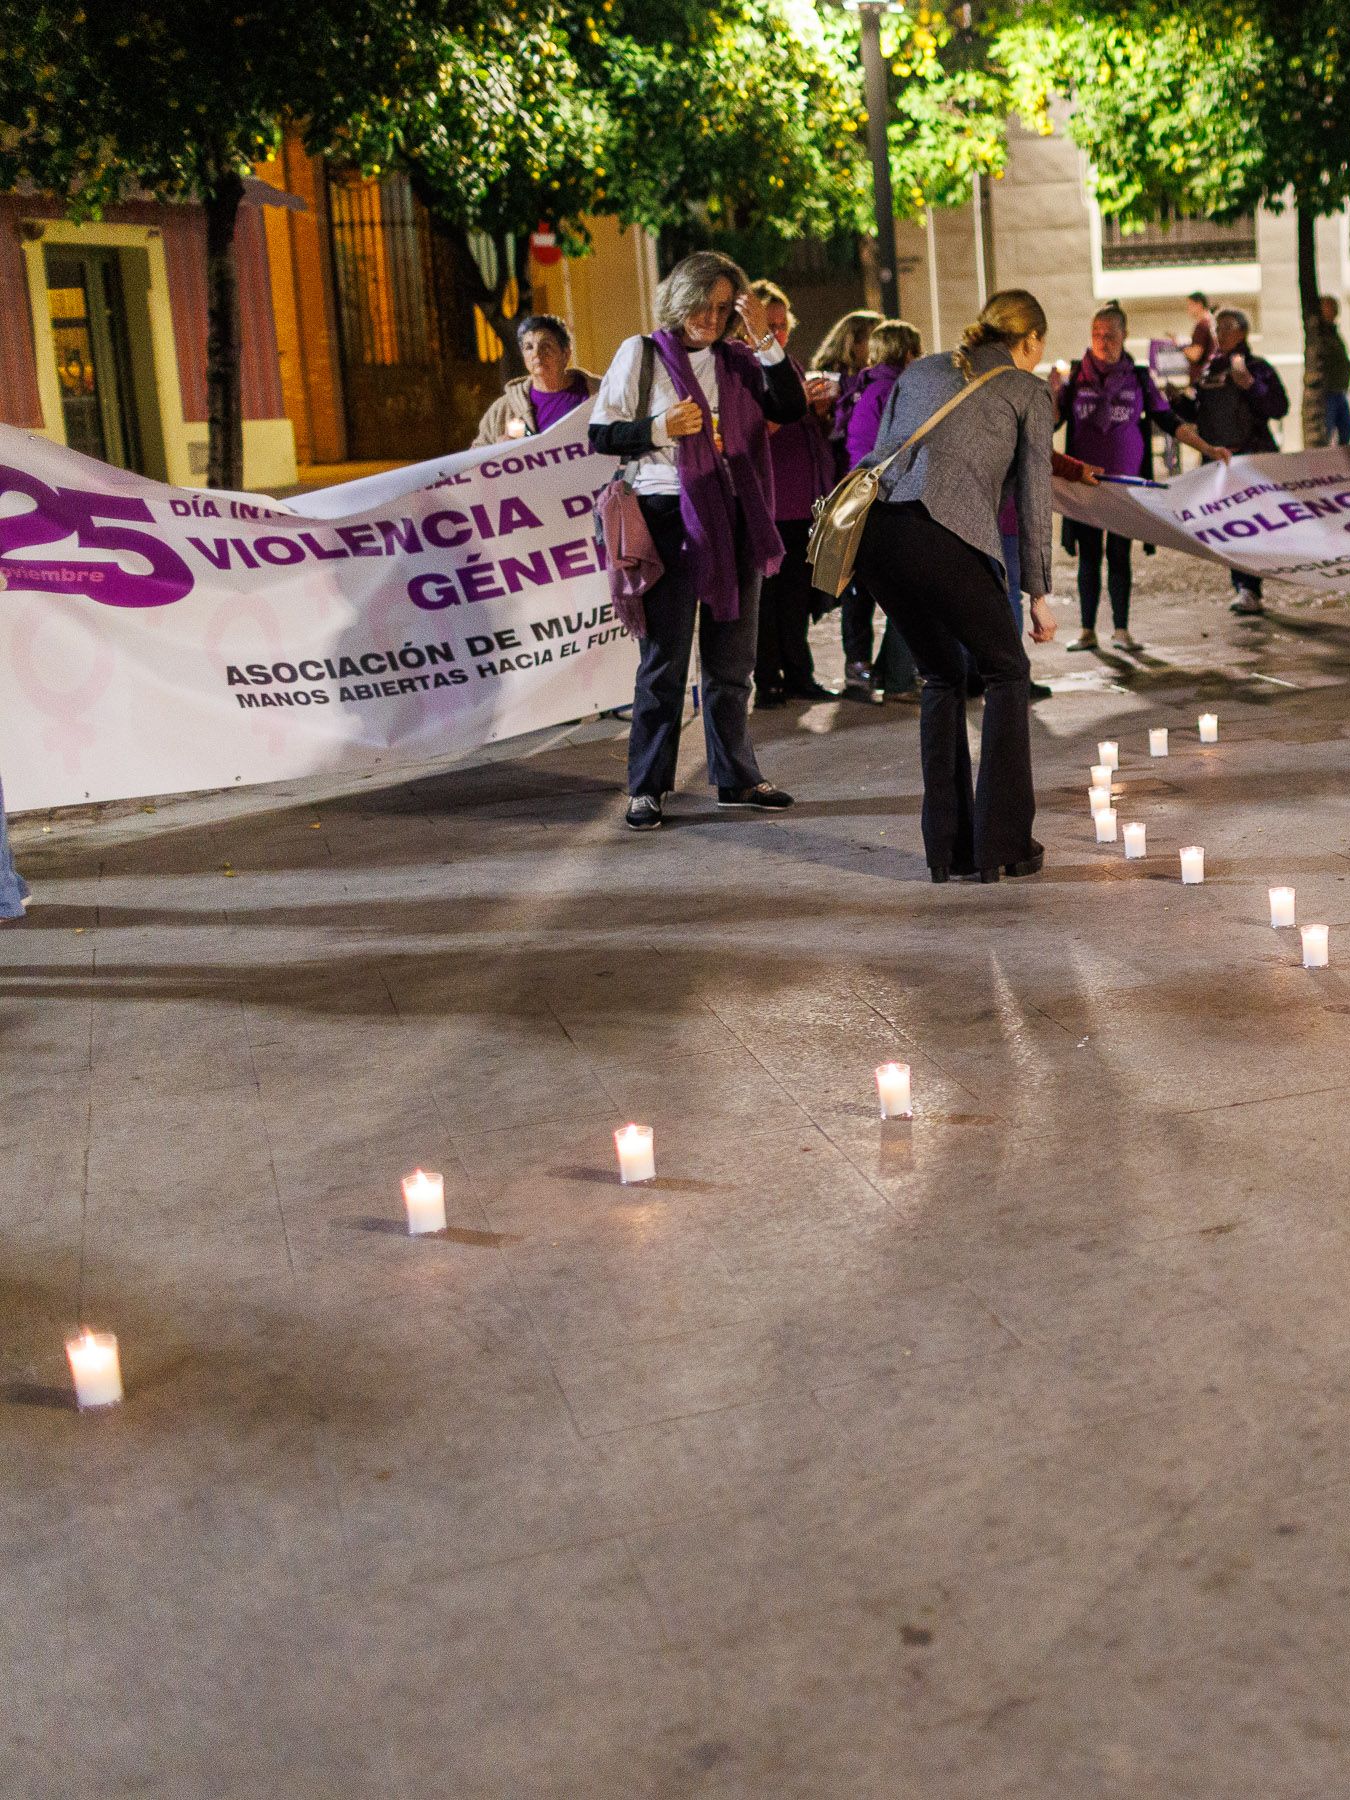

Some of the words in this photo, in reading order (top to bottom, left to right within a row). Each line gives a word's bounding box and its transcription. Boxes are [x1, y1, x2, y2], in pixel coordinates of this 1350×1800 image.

[169, 494, 222, 518] DÍA
[185, 496, 544, 570] VIOLENCIA
[562, 489, 602, 519] D
[226, 641, 455, 685] ASOCIACIÓN
[465, 628, 522, 657] DE
[530, 603, 619, 642] MUJE
[236, 689, 330, 709] MANOS
[339, 669, 469, 702] ABIERTAS
[477, 649, 553, 679] HACIA
[560, 640, 581, 659] EL
